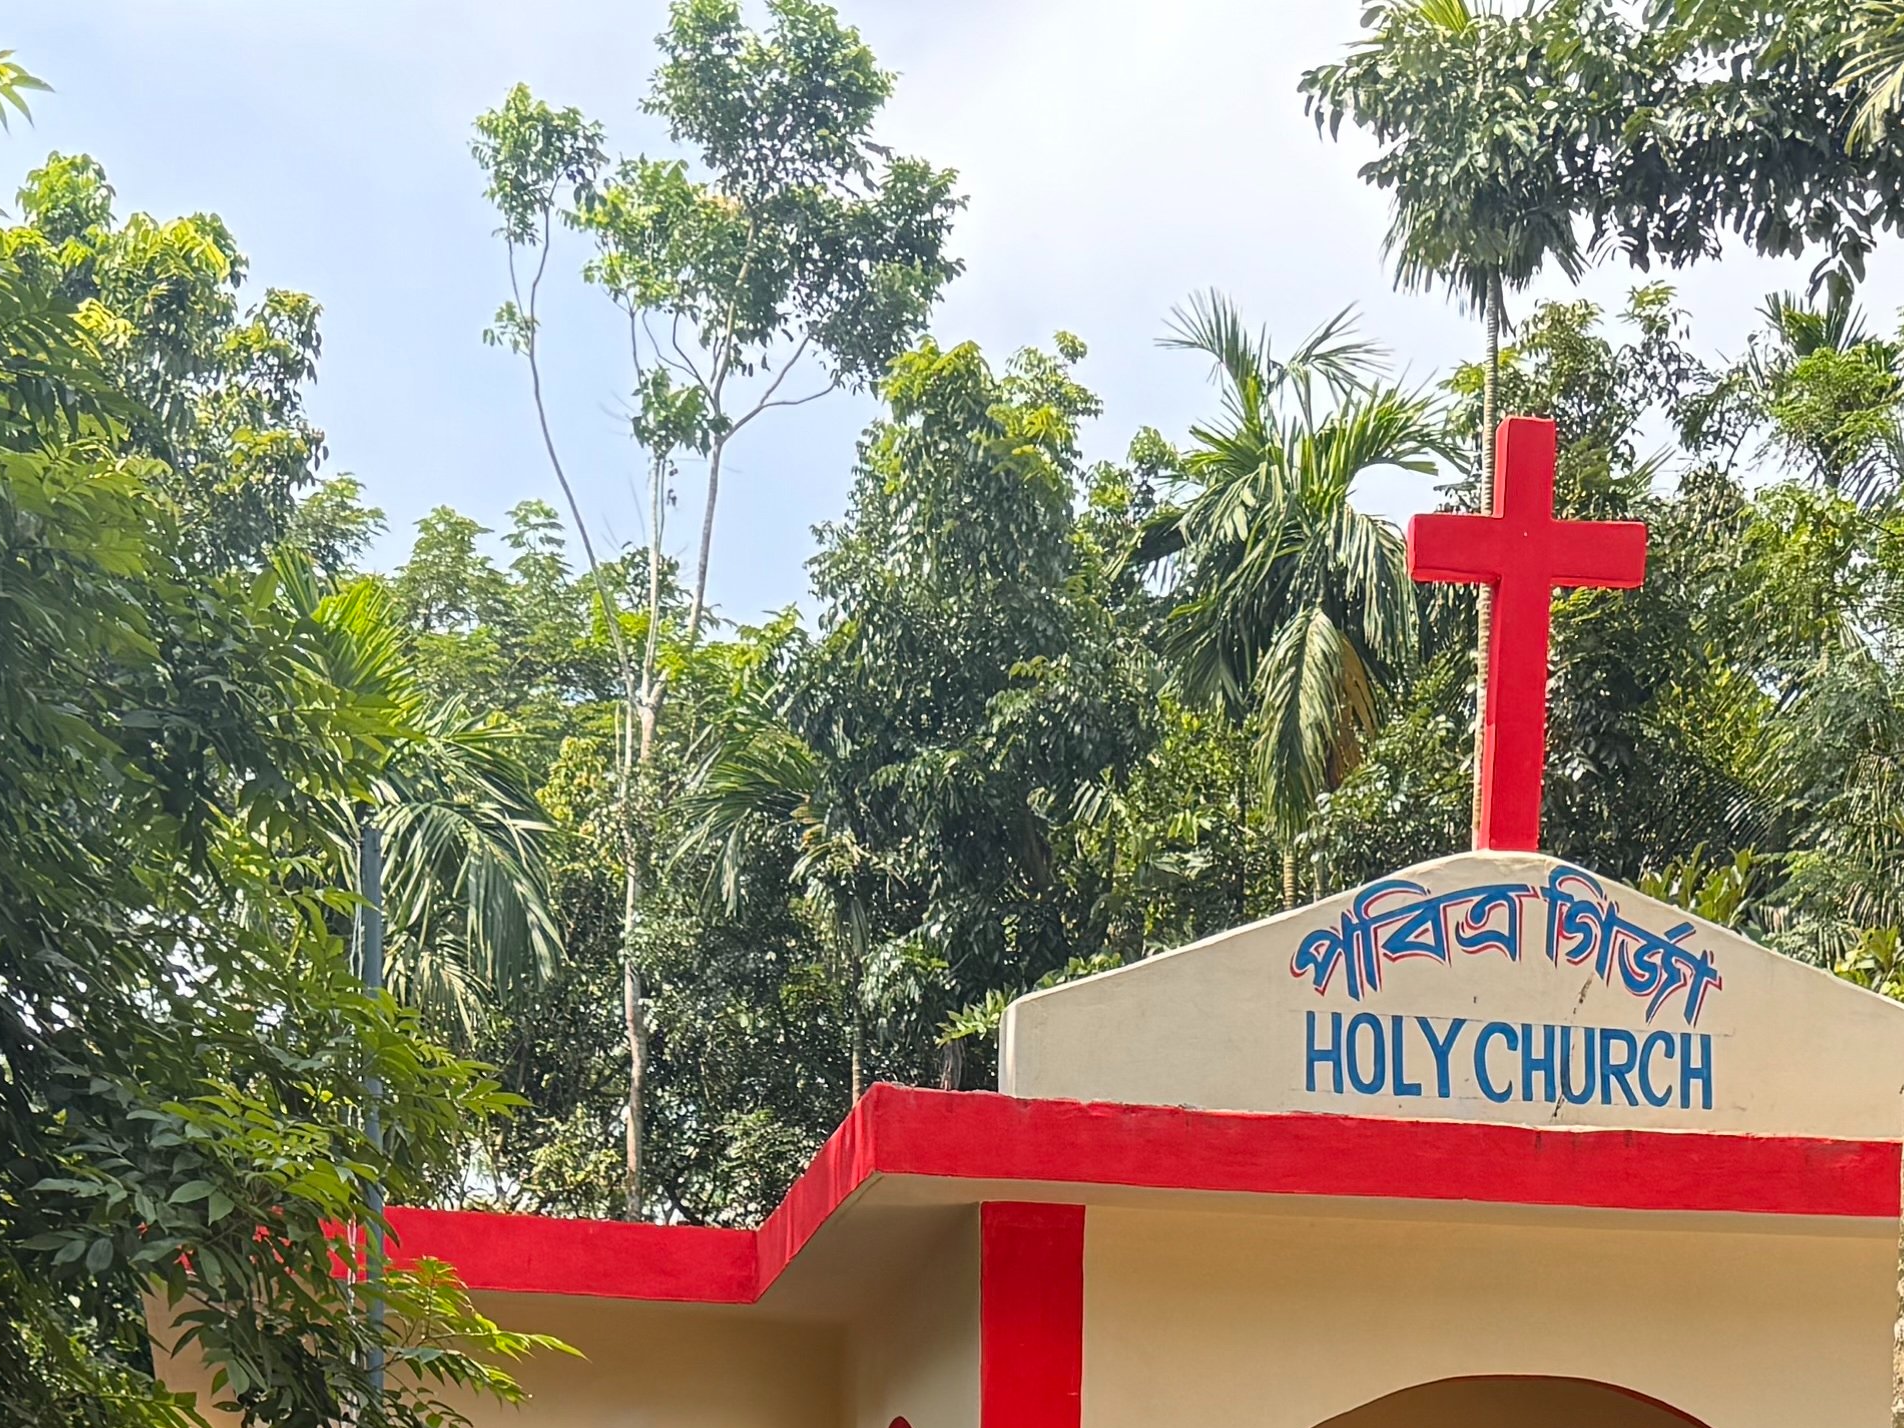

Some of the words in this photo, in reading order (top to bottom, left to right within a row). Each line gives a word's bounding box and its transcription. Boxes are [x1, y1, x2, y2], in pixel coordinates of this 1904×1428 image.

[1291, 880, 1539, 1001] পবিত্র
[1540, 865, 1723, 1028] গির্জা
[1306, 1010, 1467, 1099] HOLY
[1474, 1021, 1713, 1110] CHURCH
